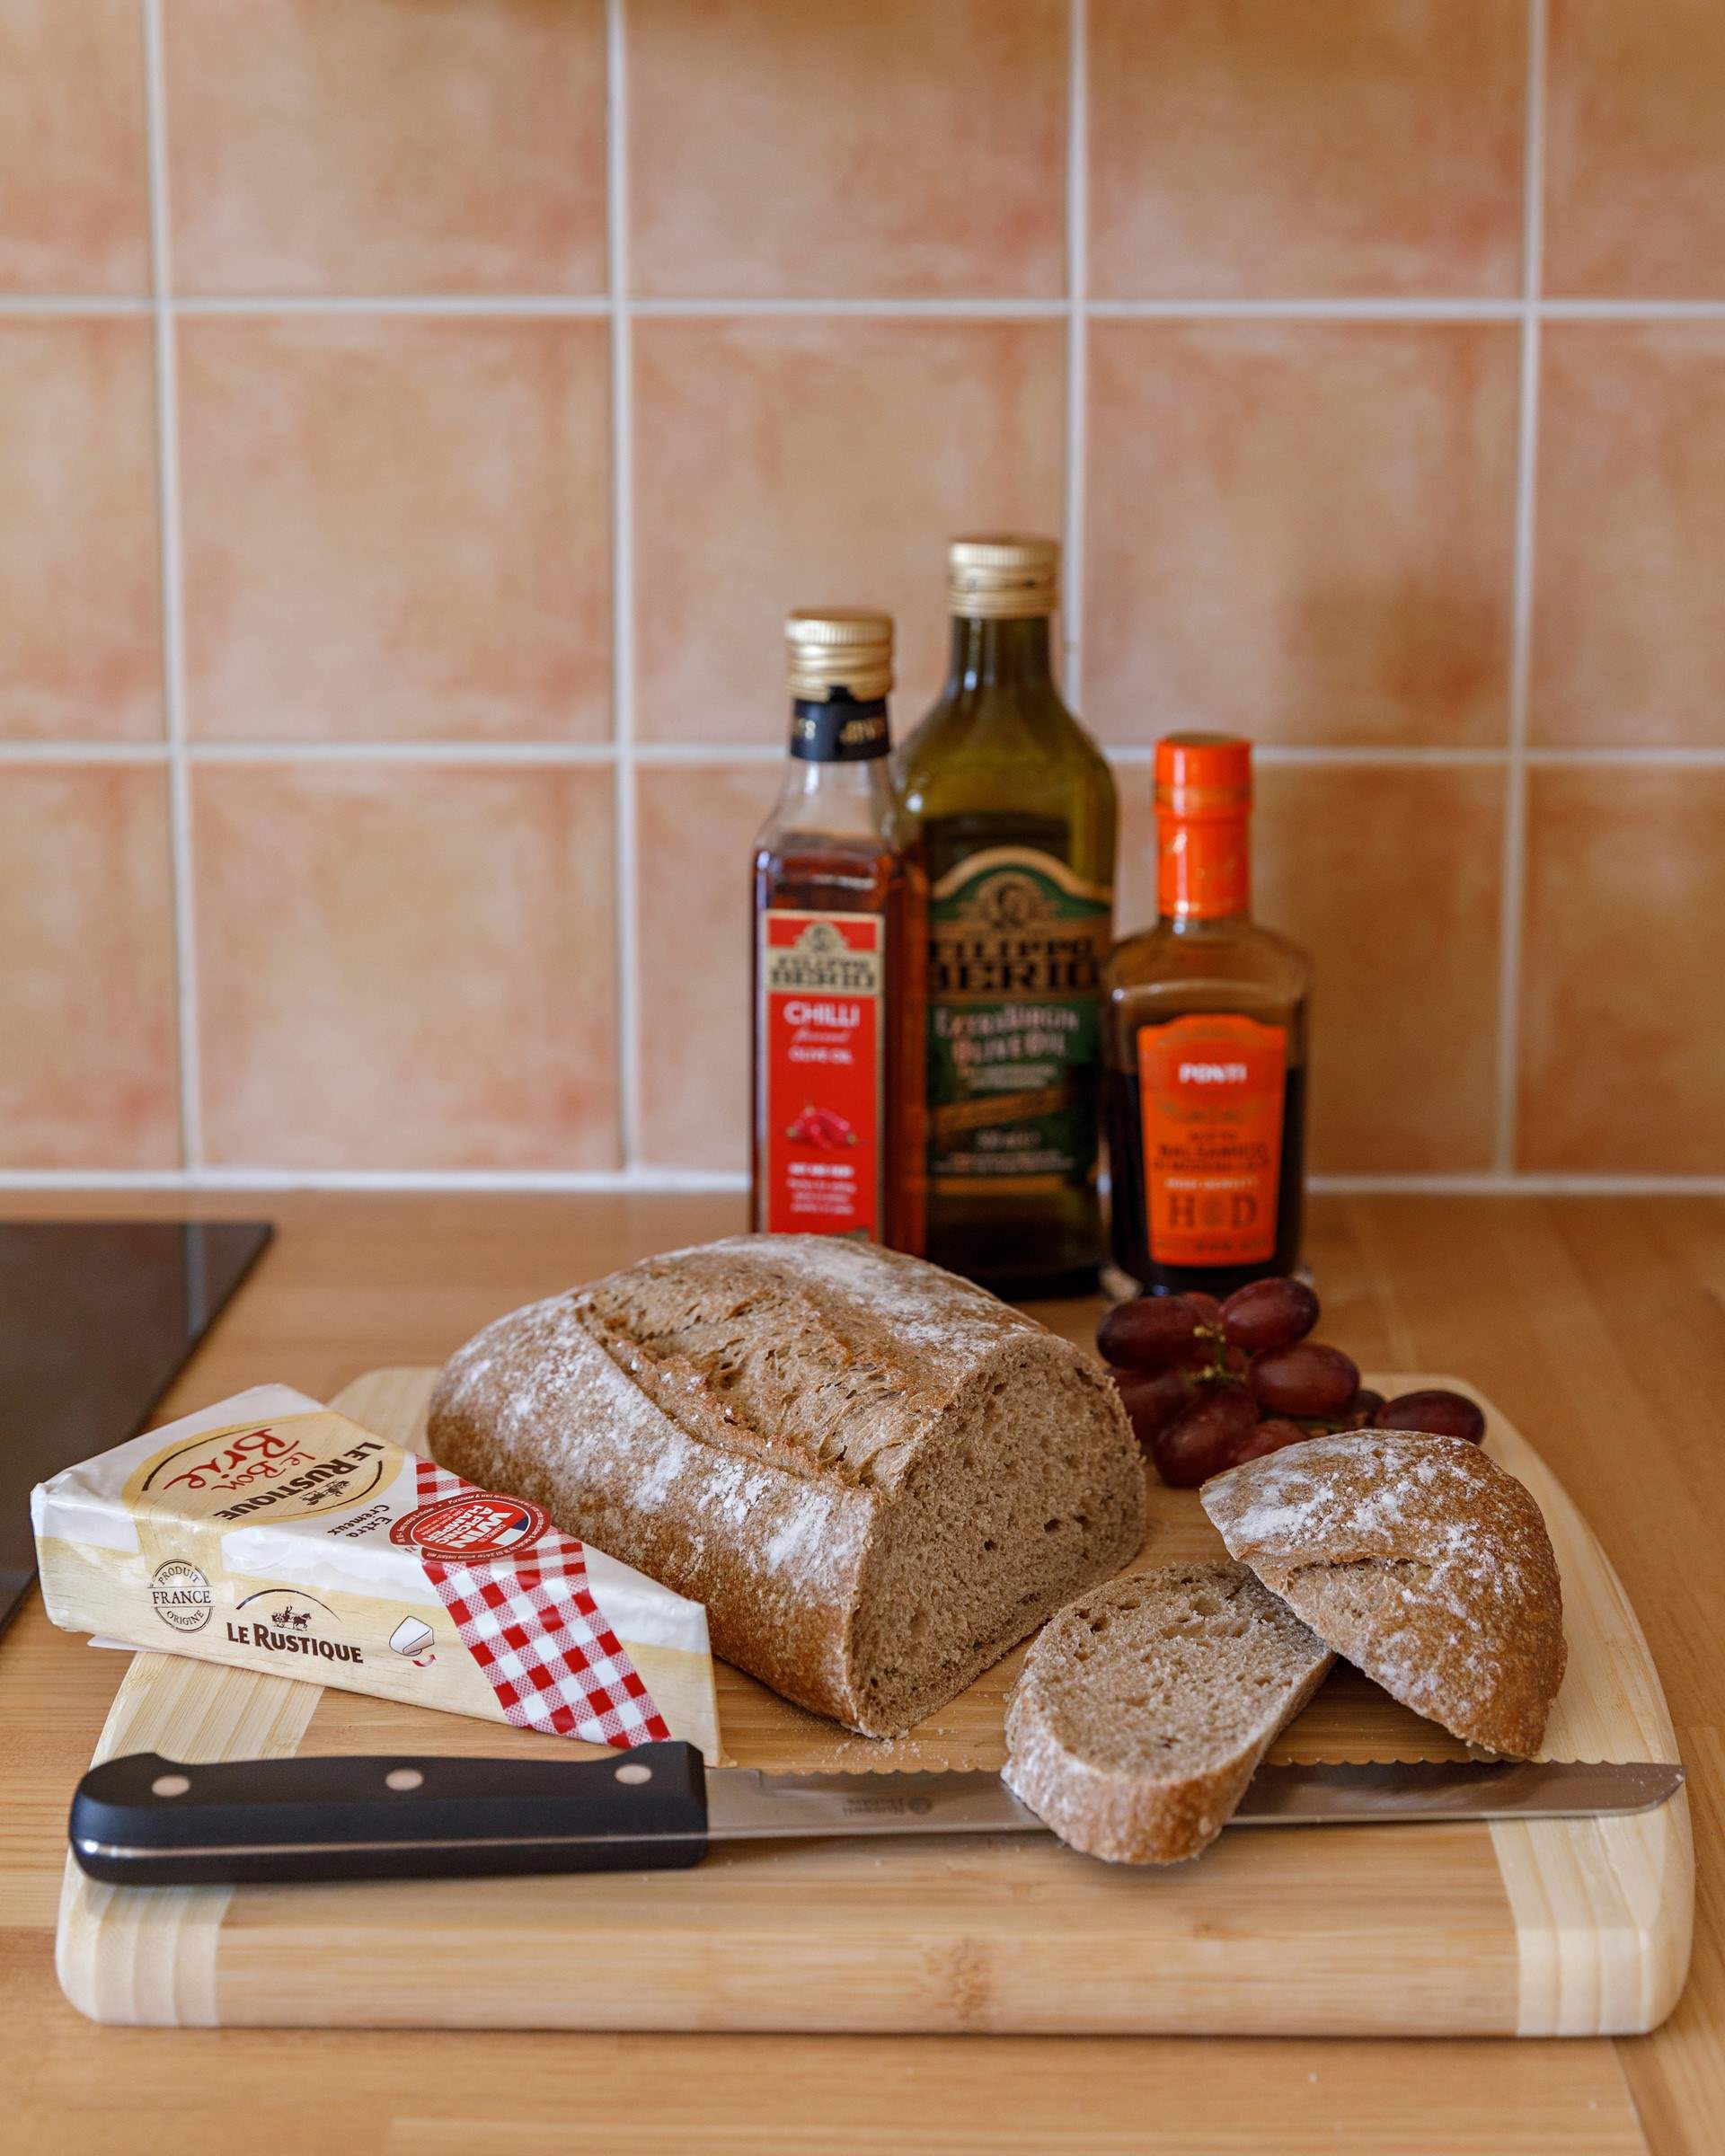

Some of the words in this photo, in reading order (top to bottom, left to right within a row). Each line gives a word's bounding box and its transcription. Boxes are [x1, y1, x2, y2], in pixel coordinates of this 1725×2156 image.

[783, 1000, 861, 1028] CHILLI
[1179, 1063, 1247, 1084] PONTI
[163, 1427, 300, 1491] Brie
[279, 1452, 316, 1467] Le
[343, 1441, 385, 1462] LE
[211, 1461, 286, 1491] Bon
[212, 1459, 359, 1521] RUSTIQUE
[480, 1507, 493, 1515] A
[345, 1517, 393, 1539] Extra
[422, 1505, 482, 1542] HAMPER
[435, 1515, 485, 1544] PICNIC
[444, 1512, 514, 1549] WIN
[157, 1566, 199, 1586] PRODUIT
[152, 1589, 212, 1605] FRANCE
[166, 1609, 206, 1627] ORIGINE
[226, 1622, 251, 1645] LE
